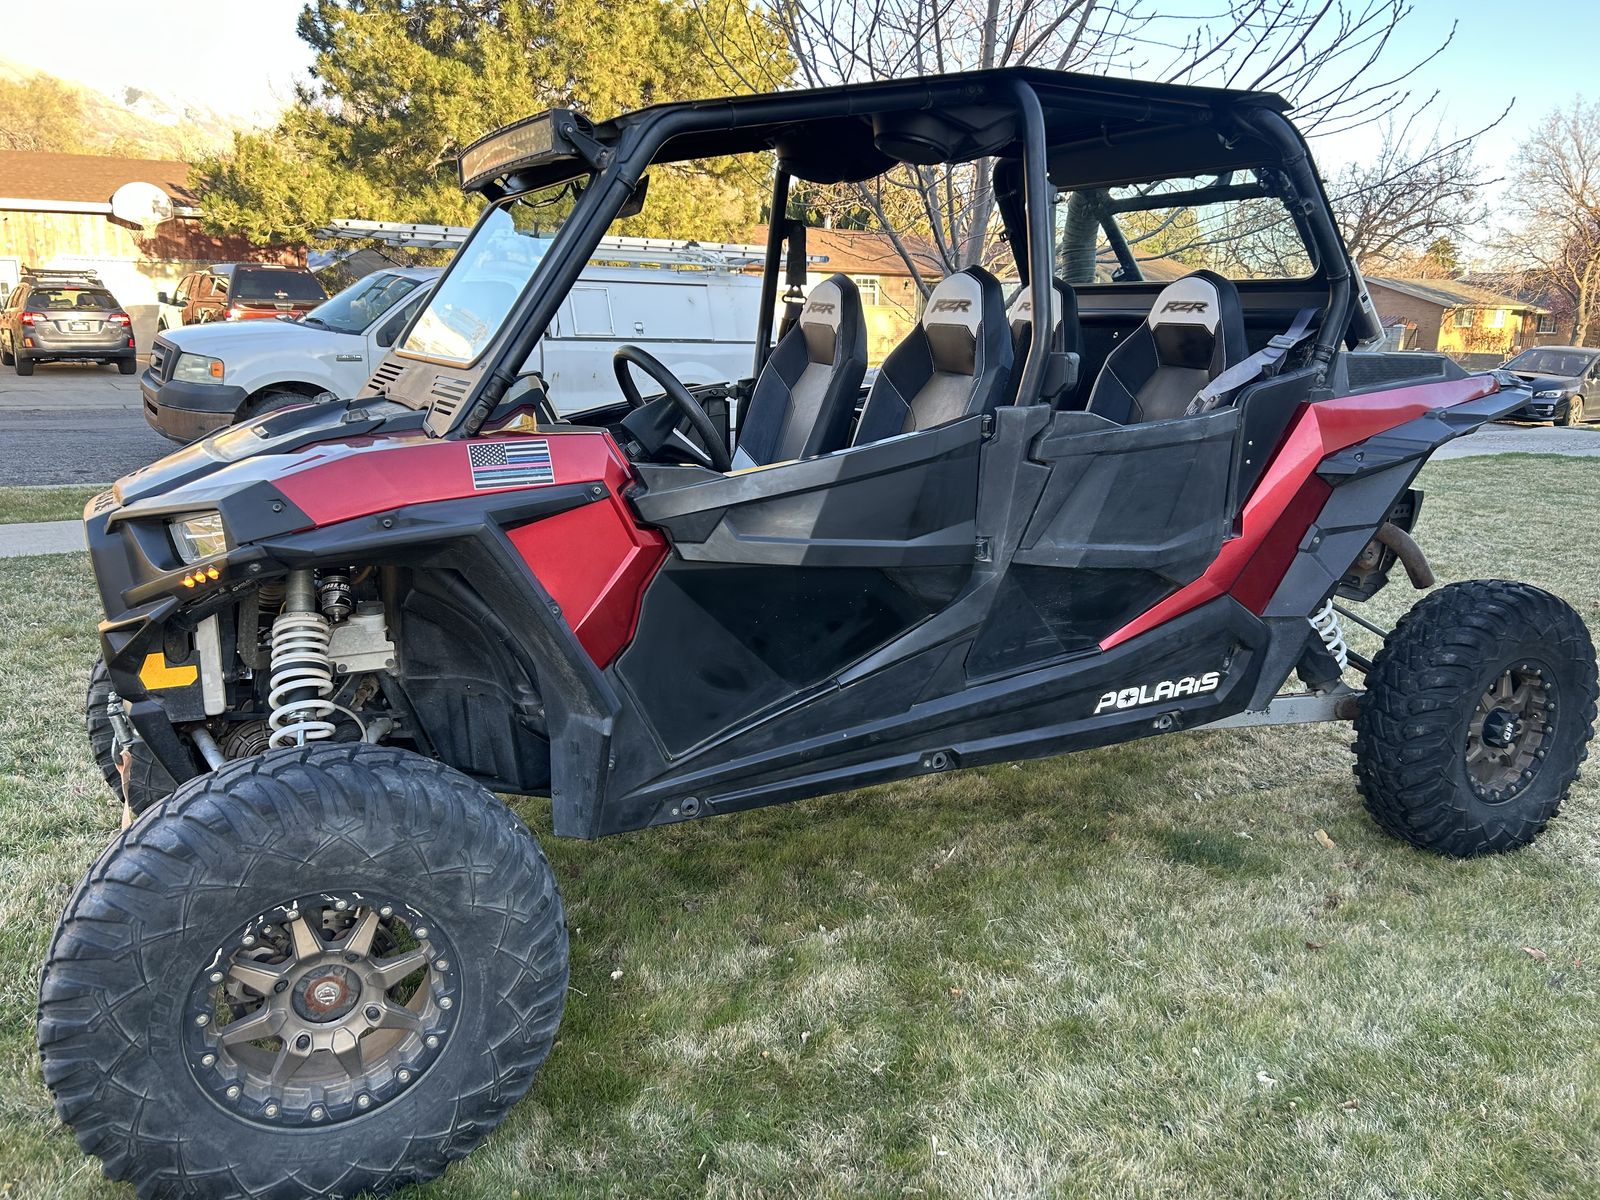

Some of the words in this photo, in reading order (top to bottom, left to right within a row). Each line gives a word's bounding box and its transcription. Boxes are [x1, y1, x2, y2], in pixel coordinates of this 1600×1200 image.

[806, 302, 836, 315] RZR
[930, 298, 972, 314] RZR
[1160, 300, 1209, 314] RZR
[1093, 671, 1221, 714] POLARIS
